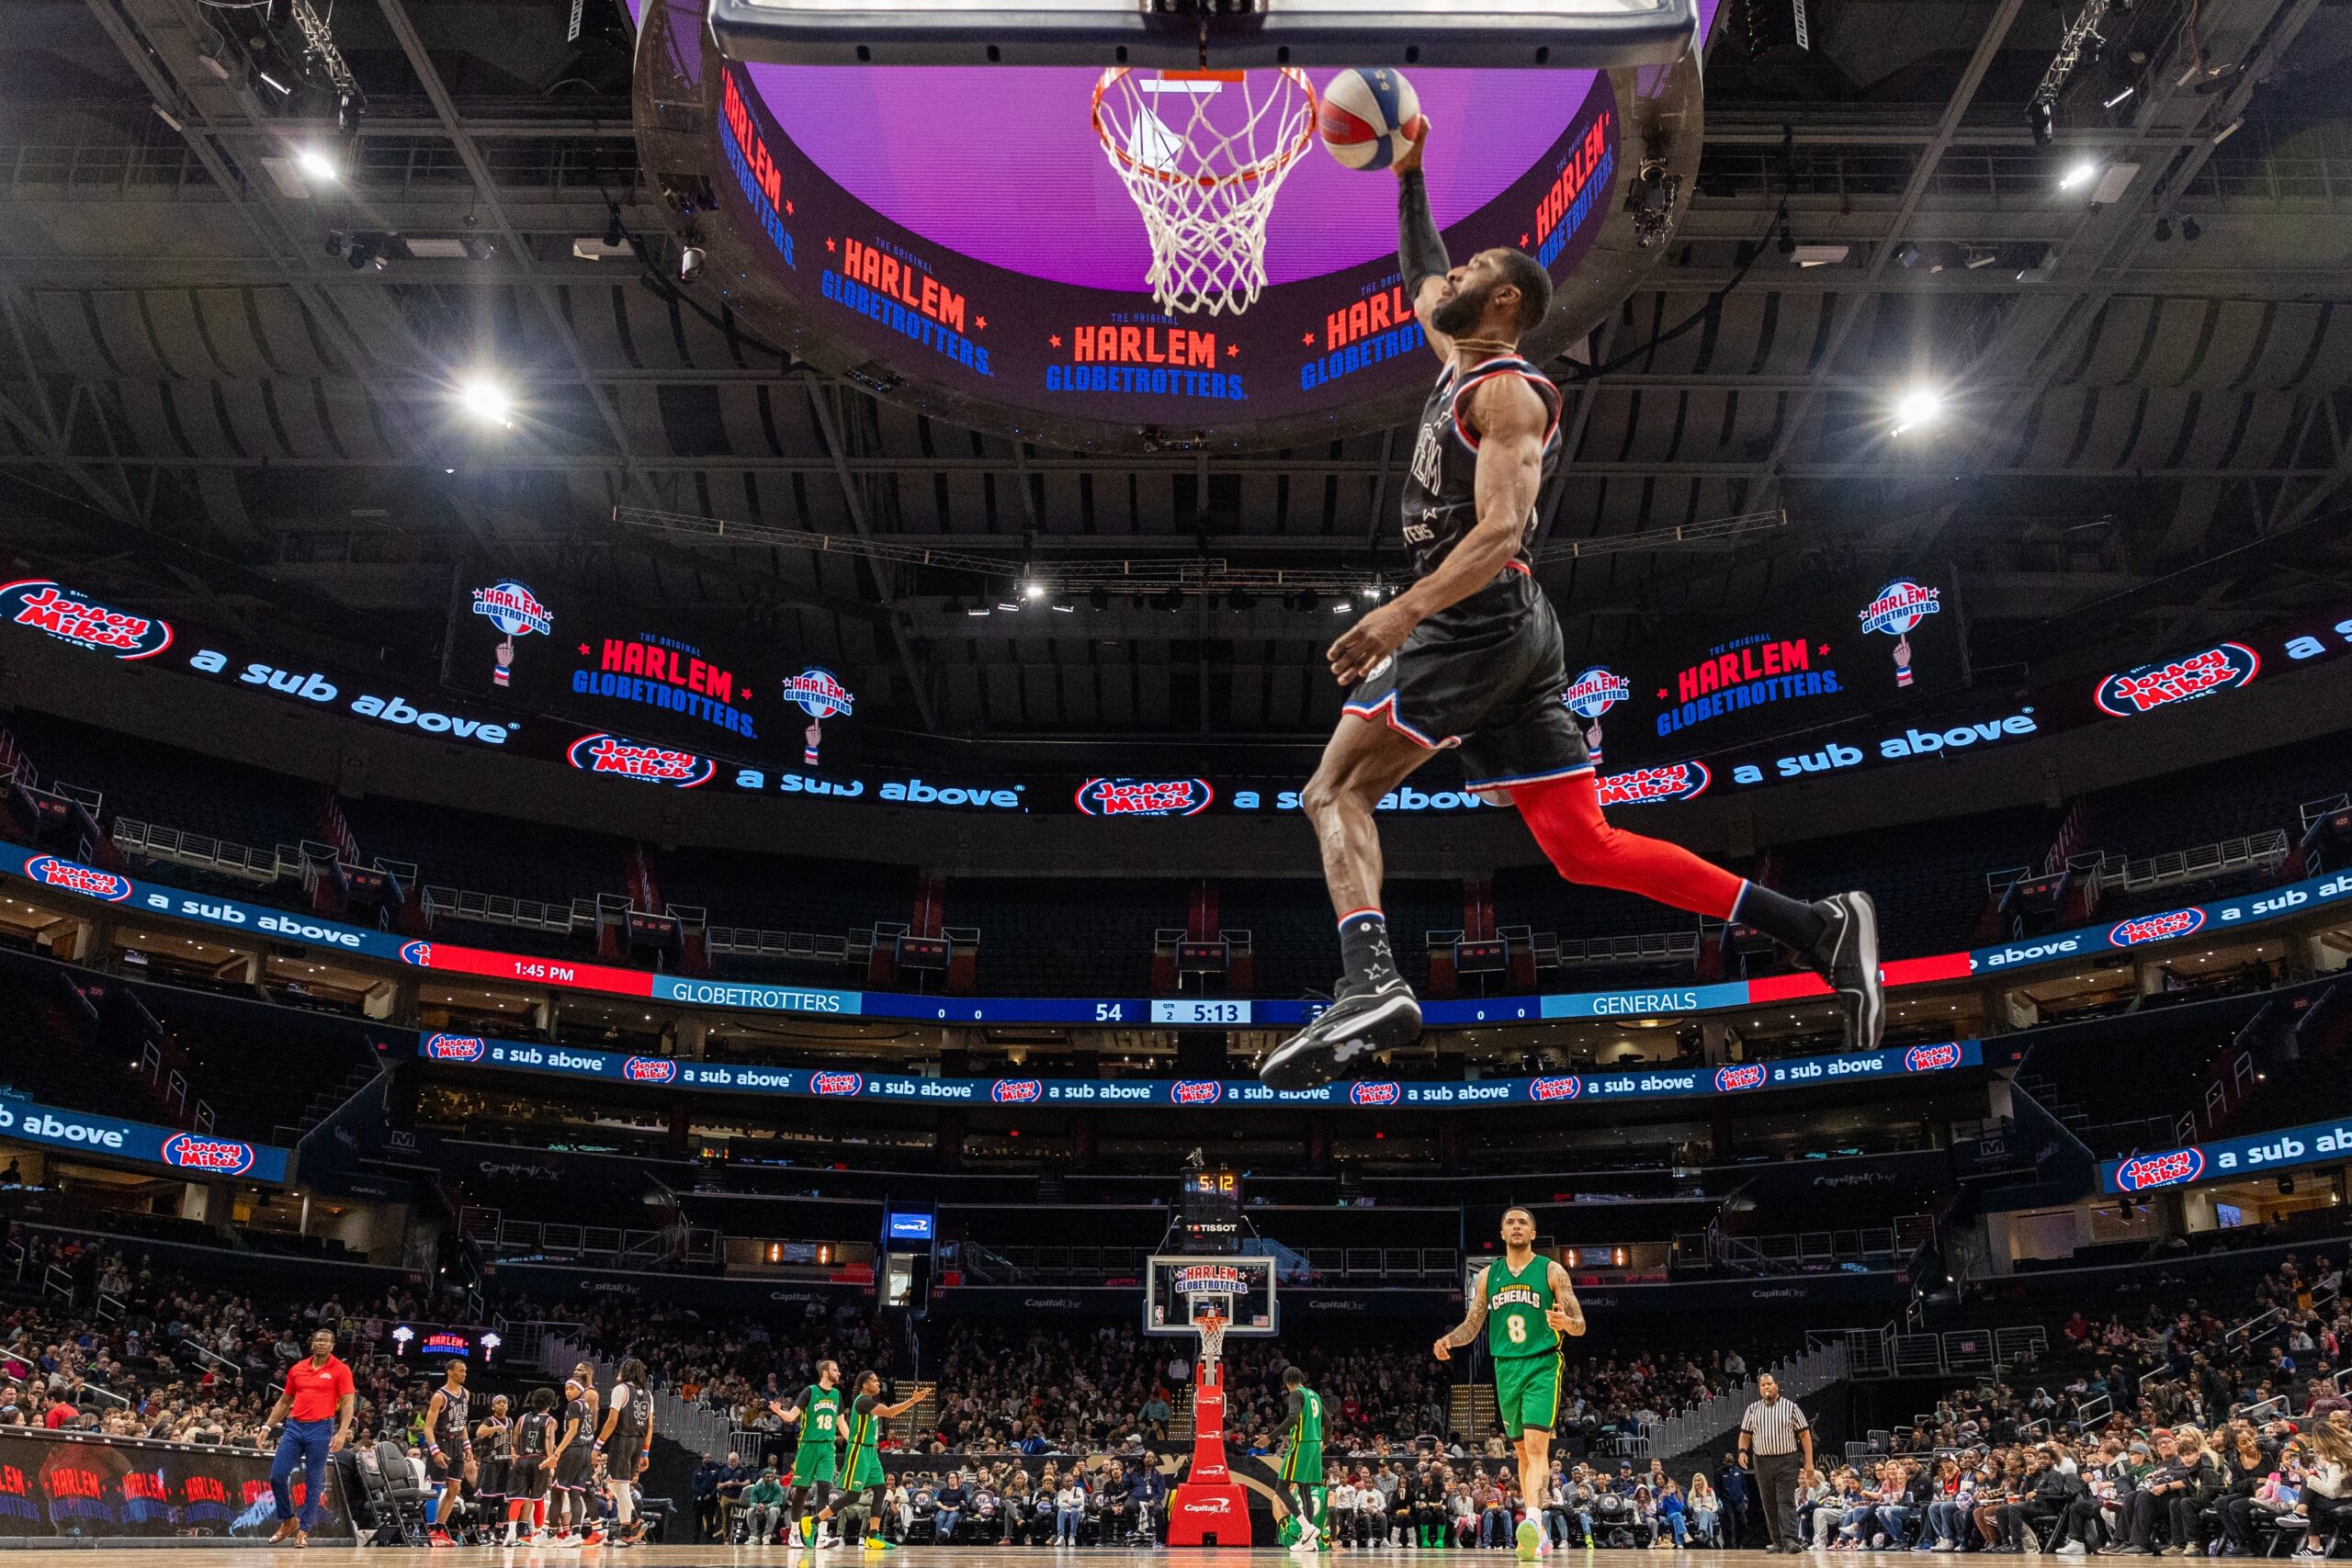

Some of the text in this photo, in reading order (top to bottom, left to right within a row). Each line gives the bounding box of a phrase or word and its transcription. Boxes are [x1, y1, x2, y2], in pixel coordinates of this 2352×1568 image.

[725, 71, 781, 213] HARLEM
[1536, 113, 1604, 246] HARLEM
[876, 236, 934, 275] THE ORIGINAL
[844, 237, 966, 333] HARLEM
[1362, 272, 1402, 297] THE ORIG
[822, 269, 989, 376] GLOBETROTTERS
[1112, 313, 1179, 325] THE ORIGINAL
[1327, 286, 1418, 352] HARL
[1074, 325, 1216, 369] HARLEM
[1300, 321, 1424, 391] GLOBETROT
[1046, 365, 1243, 401] GLOBETROTTERS
[20, 588, 151, 637] Jersey
[484, 588, 544, 618] HARLEM
[1870, 587, 1928, 618] HARLEM
[14, 606, 141, 649] Mike's
[473, 601, 551, 636] GLOBETROTTERS
[1863, 600, 1939, 634] GLOBETROTTERS
[639, 632, 702, 658] THE ORIGINAL
[1709, 631, 1771, 657] THE ORIGINAL
[2284, 636, 2326, 660] a
[190, 649, 228, 673] a
[240, 663, 338, 702] sub
[601, 638, 732, 705] HARLEM
[1679, 638, 1809, 704] HARLEM
[2115, 649, 2229, 698] Jersey
[793, 676, 846, 702] HARLEM
[1568, 675, 1620, 701] HARLEM
[2131, 667, 2240, 712] Mike's
[572, 670, 754, 739] GLOBETROTTERS
[784, 688, 853, 716] GLOBETROTTERS
[1566, 689, 1628, 711] LOBETROTTERS
[1657, 670, 1839, 737] GLOBETROTTERS
[590, 739, 695, 768] Jersey
[1734, 764, 1763, 784] a
[1777, 743, 1863, 777] sub
[594, 756, 694, 780] Mike's
[736, 769, 764, 789] a
[1595, 761, 1688, 790] Jersey
[1093, 779, 1193, 801] Jersey
[1233, 790, 1260, 809] a
[1375, 787, 1482, 809] abov
[1599, 783, 1692, 807] Mike's
[1102, 795, 1193, 816] Mike's
[40, 860, 117, 888] Jersey
[47, 874, 118, 897] Mike's
[147, 893, 169, 909] a
[182, 898, 246, 924] sub
[2221, 890, 2308, 921] a sub
[2120, 910, 2190, 937] Jersey
[2126, 922, 2190, 945] Mike's
[514, 962, 574, 981] 1:45 PM
[673, 983, 840, 1012] GLOBETROTTERS
[1593, 993, 1697, 1015] GENERALS
[938, 1009, 945, 1019] 0
[975, 1010, 982, 1020] 0
[1096, 1003, 1123, 1021] 54
[1166, 1011, 1173, 1021] 2
[1193, 1003, 1239, 1022] 5:13
[1477, 1010, 1485, 1021] 0
[1518, 1009, 1525, 1018] 0
[435, 1037, 476, 1050] Jersey
[438, 1046, 477, 1058] Mike's
[1911, 1043, 1953, 1061] Jersey
[492, 1048, 504, 1059] a
[510, 1049, 542, 1065] sub
[631, 1058, 669, 1072] Jersey
[1917, 1054, 1953, 1070] Mike's
[633, 1067, 669, 1081] Mike's
[684, 1069, 695, 1081] a
[699, 1069, 732, 1085] sub
[817, 1072, 854, 1086] Jersey
[1721, 1064, 1758, 1080] Jersey
[1726, 1074, 1758, 1090] Mike's
[1774, 1068, 1785, 1080] a
[1791, 1062, 1822, 1078] sub
[820, 1082, 855, 1094] Mike's
[869, 1081, 880, 1093] a
[885, 1079, 916, 1095] sub
[996, 1081, 1035, 1095] Jersey
[1001, 1089, 1035, 1102] Mike's
[1049, 1086, 1059, 1099] a
[1065, 1084, 1095, 1100] sub
[1178, 1082, 1214, 1094] Jersey
[1228, 1083, 1274, 1100] a sub
[1357, 1082, 1394, 1096] Jersey
[1408, 1089, 1418, 1100] a
[1423, 1086, 1453, 1100] sub
[1535, 1077, 1572, 1092] Jersey
[1540, 1087, 1573, 1100] Mike's
[1589, 1082, 1599, 1094] a
[1604, 1077, 1635, 1093] sub
[1181, 1090, 1215, 1103] Mike's
[1360, 1091, 1394, 1104] Mike's
[175, 1138, 242, 1157] Jersey
[2219, 1152, 2237, 1168] a
[2248, 1137, 2305, 1164] sub
[180, 1152, 241, 1168] Mike's
[2128, 1151, 2190, 1177] Jersey
[1199, 1175, 1234, 1191] 5:12
[2135, 1164, 2193, 1190] Mike's
[1200, 1224, 1238, 1232] TISSOT
[1186, 1265, 1238, 1280] HARLEM
[1175, 1280, 1249, 1294] GLOBETROTTERS
[1491, 1290, 1542, 1311] GENERALS
[1507, 1314, 1527, 1344] 8
[429, 1336, 464, 1348] HARLEM
[1961, 1342, 1975, 1352] EXIT
[816, 1414, 833, 1430] 18
[528, 1430, 538, 1448] 7
[51, 1468, 100, 1500] HARLEM
[121, 1472, 167, 1504] HARLEM
[185, 1475, 225, 1505] HARLEM
